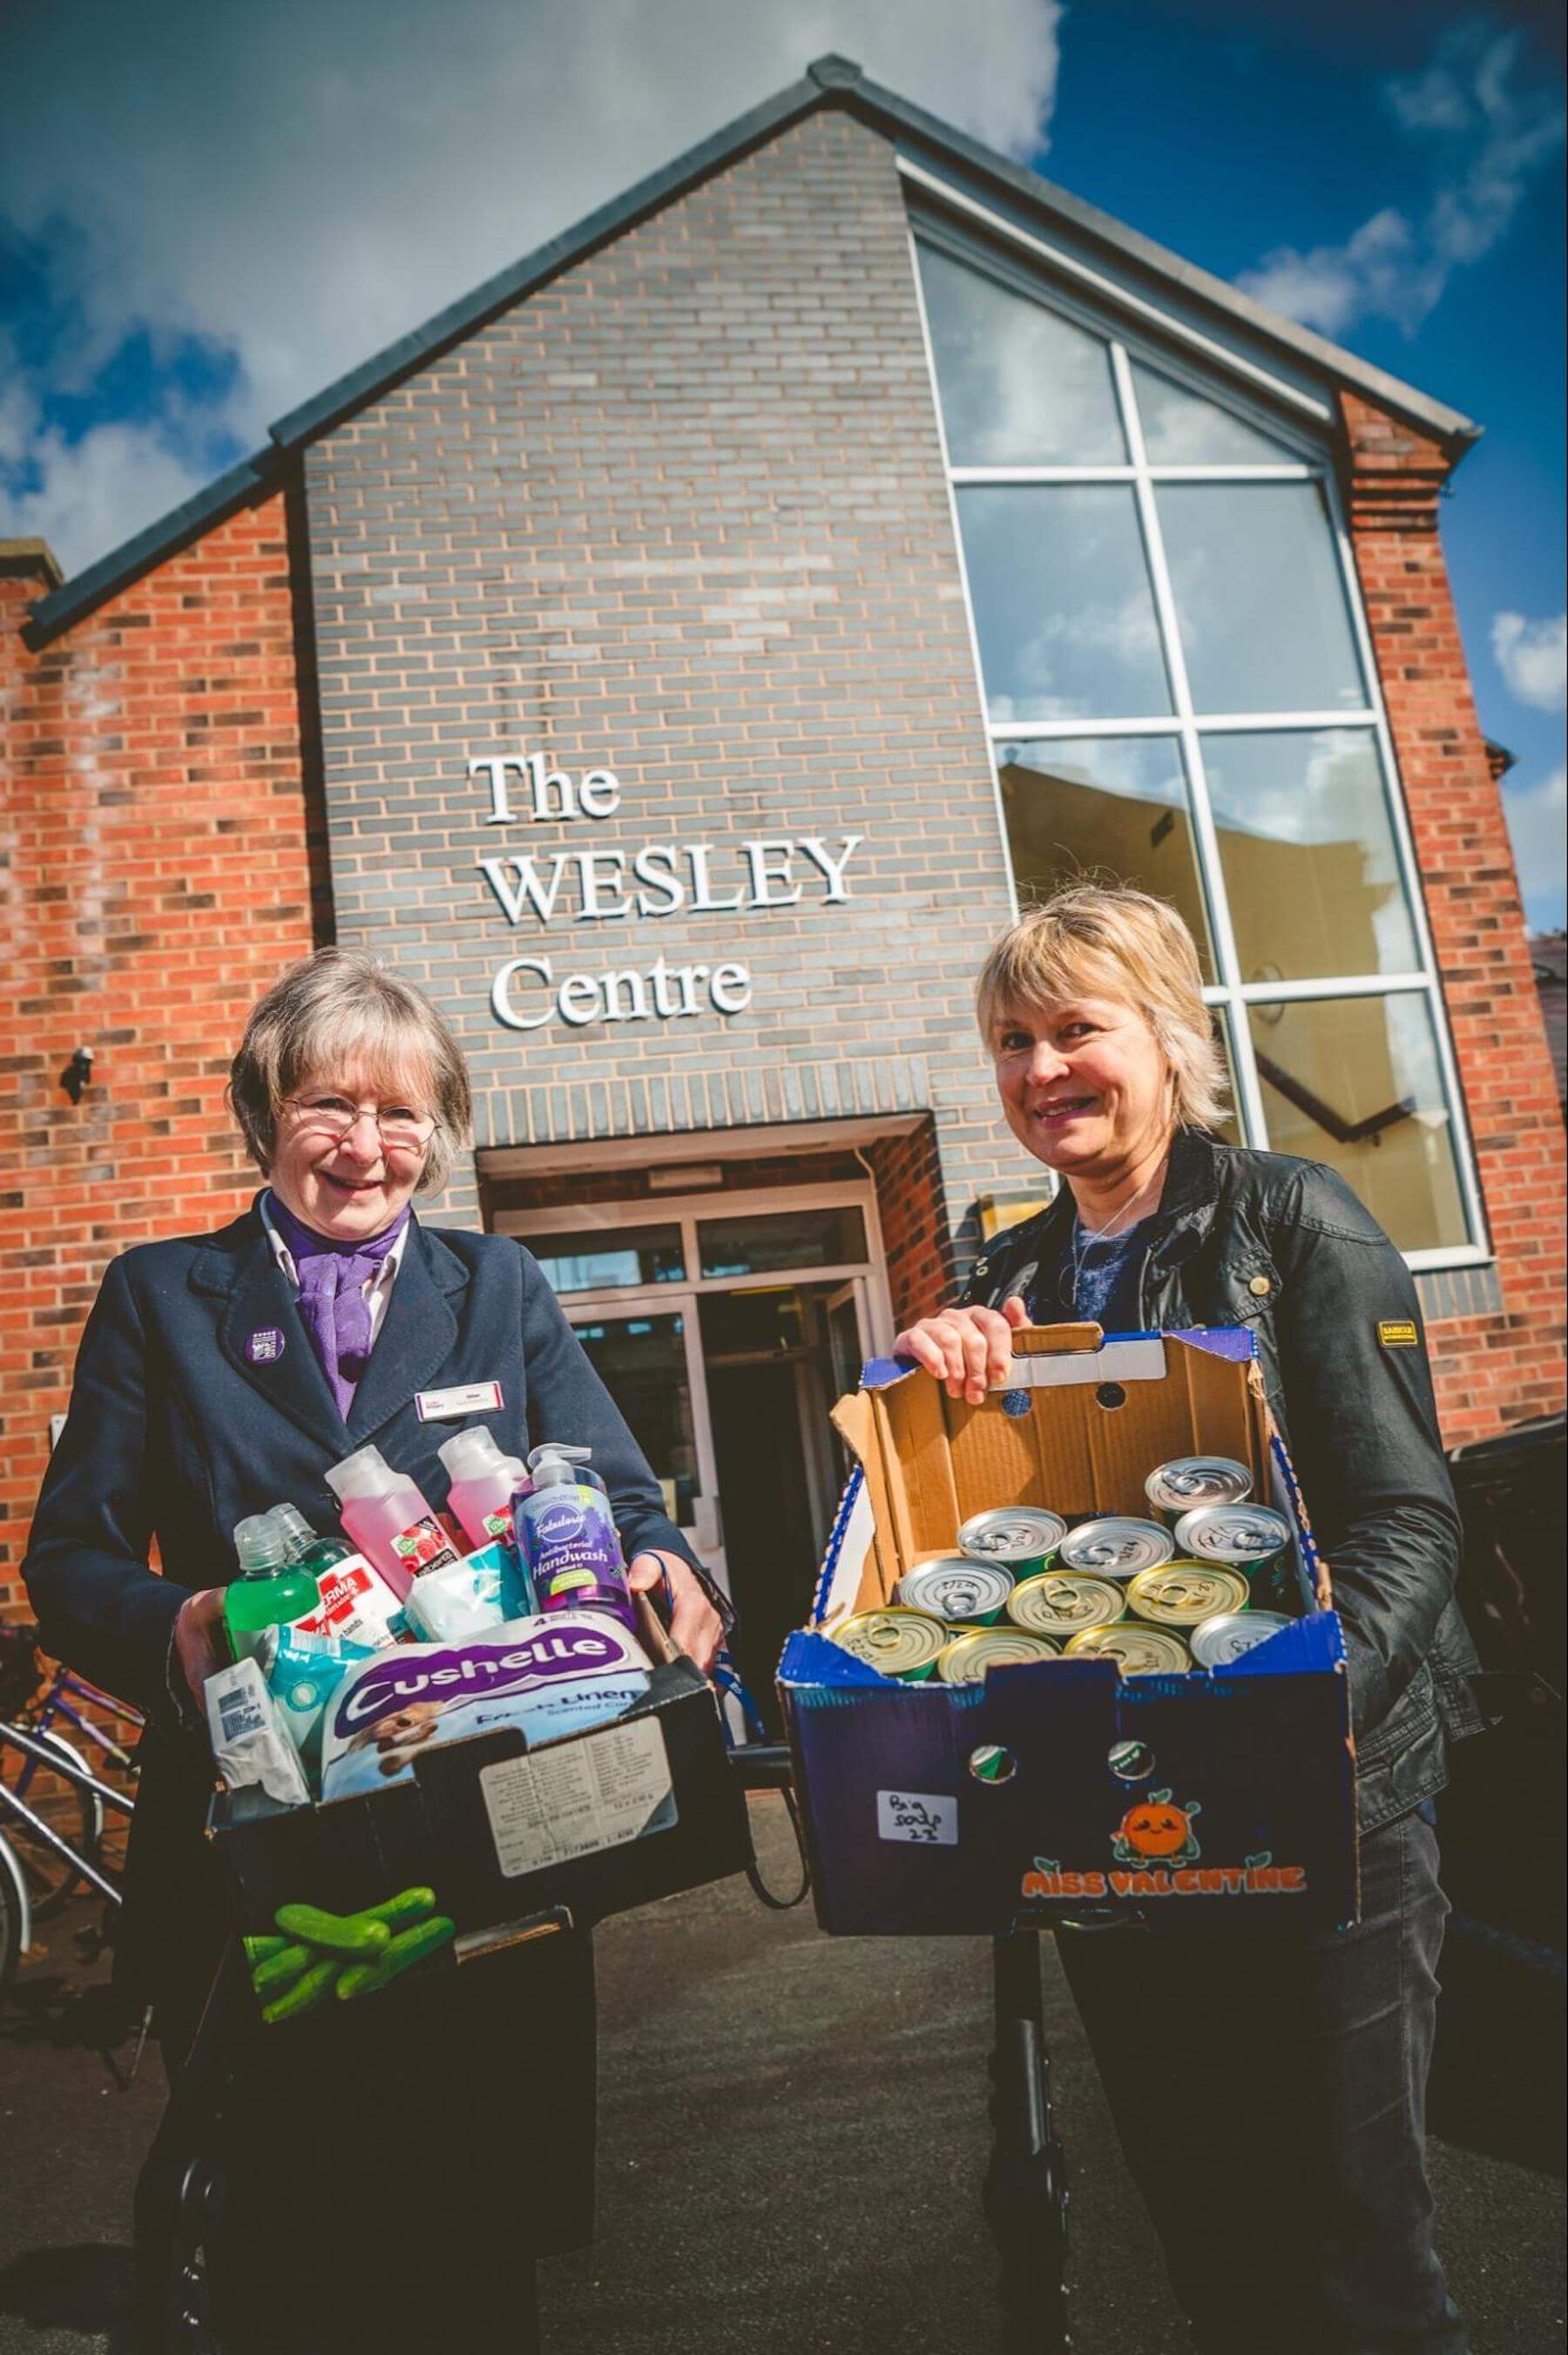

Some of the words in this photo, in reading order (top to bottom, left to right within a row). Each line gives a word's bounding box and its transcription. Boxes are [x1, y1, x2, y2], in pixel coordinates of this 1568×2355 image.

[469, 752, 621, 824] The
[478, 835, 866, 925] WESLEY
[490, 955, 754, 1030] Centre
[532, 1548, 609, 1581] Handwash
[346, 1635, 608, 1722] Cushelle
[1021, 1870, 1107, 1898] MISS
[1107, 1866, 1306, 1897] VALENTINE
